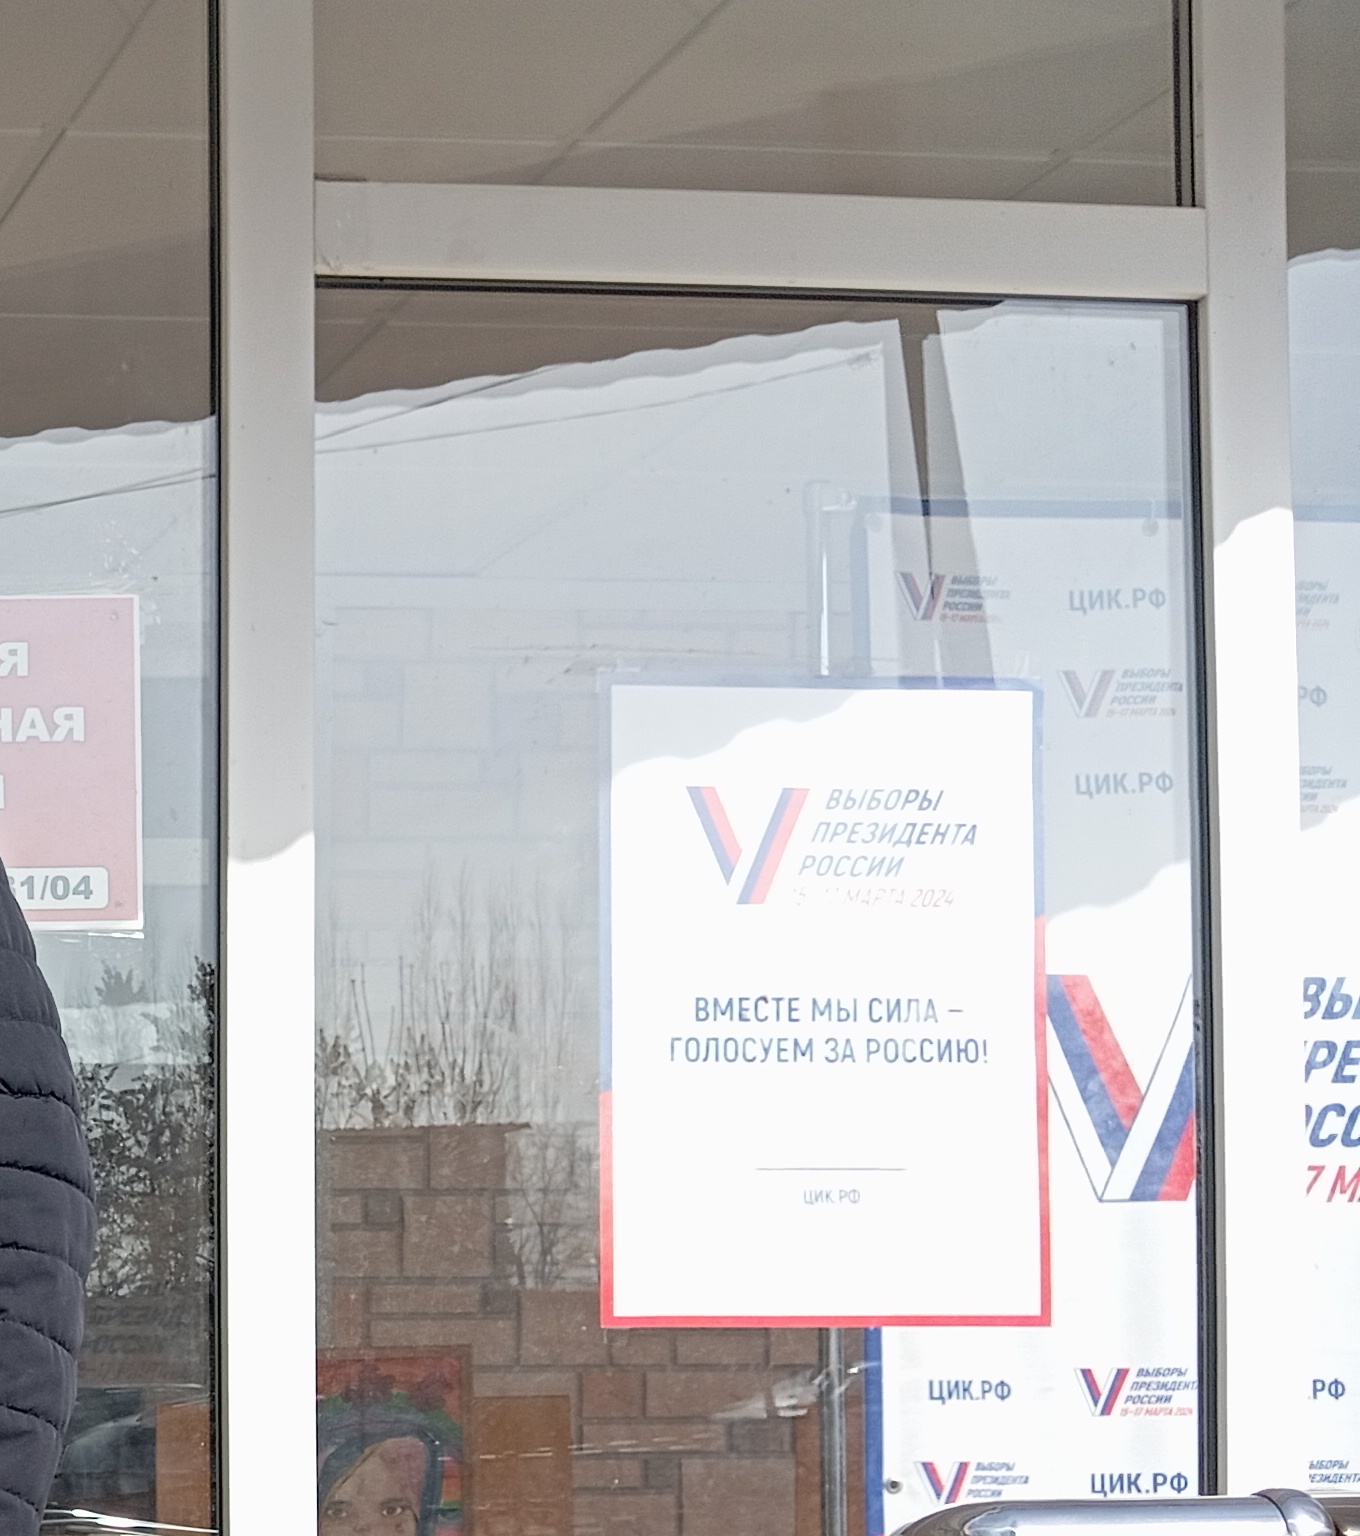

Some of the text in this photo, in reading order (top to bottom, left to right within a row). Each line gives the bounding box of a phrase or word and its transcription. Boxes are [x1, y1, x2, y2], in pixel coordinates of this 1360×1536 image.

[1068, 587, 1166, 615] ЦИК.РФ
[1074, 771, 1174, 800] ЦИК.РФ
[825, 788, 945, 812] ВЫБОРЫ
[811, 821, 979, 848] ПРЕЗИДЕНТА
[798, 855, 906, 878] РОССИИ
[694, 995, 801, 1022] ВМЕСТЕ
[811, 997, 858, 1023] МЫ
[868, 997, 939, 1023] СИЛА
[670, 1036, 988, 1064] ГОЛОСУЕМ ЗА РОССИЮ!
[1136, 1367, 1189, 1378] ВЫБОРЫ
[928, 1379, 1012, 1405] ЦИК.РФ
[1123, 1394, 1173, 1405] РОССИИ
[1308, 1459, 1350, 1470] ЫБОРЫ
[1090, 1472, 1189, 1498] ЦИК.РФ
